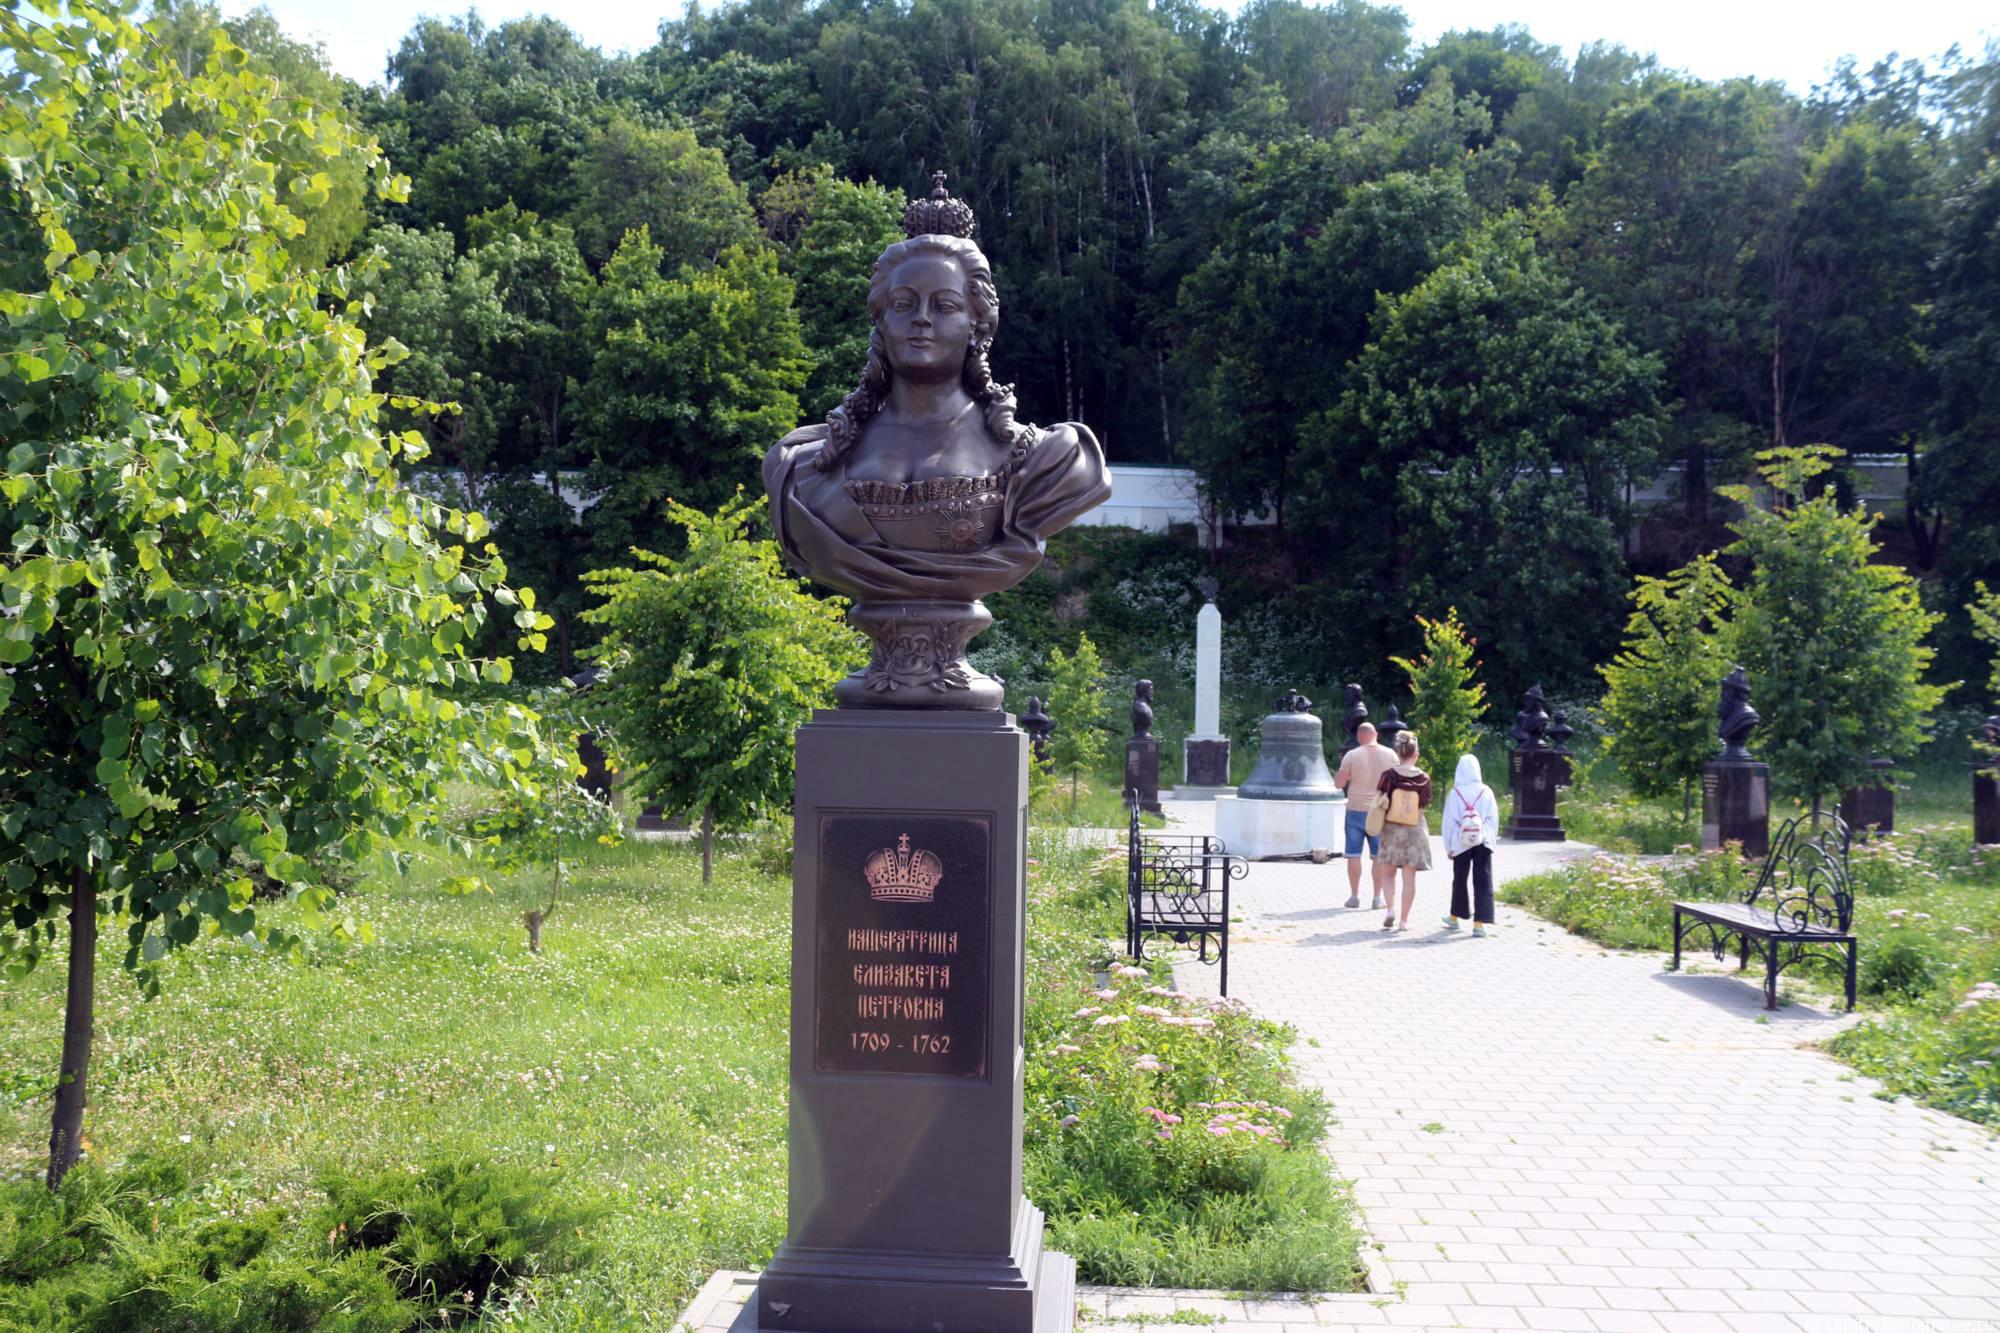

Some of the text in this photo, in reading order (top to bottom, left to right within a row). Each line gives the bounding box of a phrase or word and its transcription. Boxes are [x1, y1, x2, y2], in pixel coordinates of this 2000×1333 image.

[847, 928, 958, 957] ИМПЕРАТРИЦА
[853, 963, 951, 989] ЕЛИЗАВЕТА
[858, 994, 944, 1020] ПЕТРОВНА
[850, 1032, 891, 1053] 1709
[912, 1034, 951, 1055] 1762
